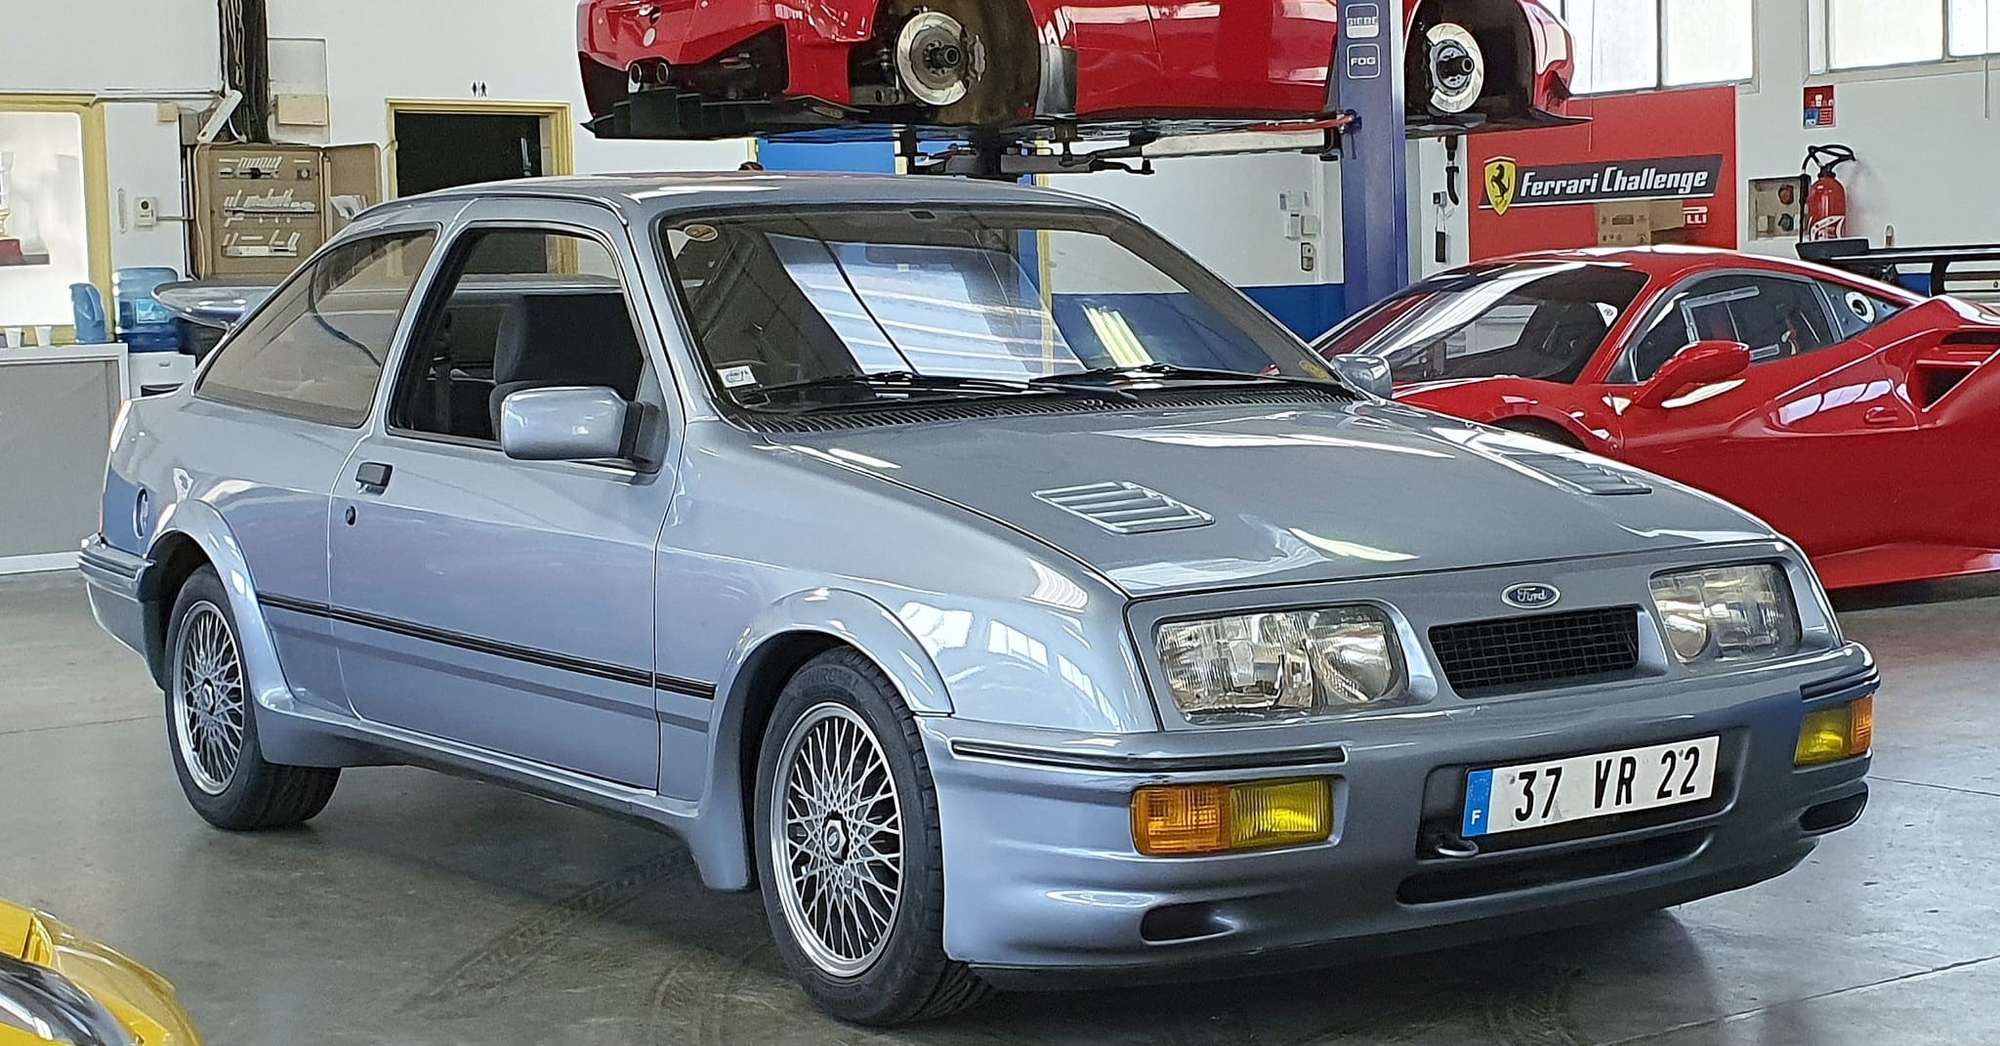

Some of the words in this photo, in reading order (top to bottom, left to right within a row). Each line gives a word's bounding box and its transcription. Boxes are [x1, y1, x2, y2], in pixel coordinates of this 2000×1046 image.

[1351, 56, 1376, 67] FOG
[1520, 172, 1599, 197] Ferrari
[1601, 167, 1708, 194] Challenge
[1517, 587, 1547, 602] Ford
[1515, 767, 1562, 821] 37
[1595, 756, 1637, 809] VR
[1657, 746, 1700, 799] 22
[1471, 809, 1482, 825] F
